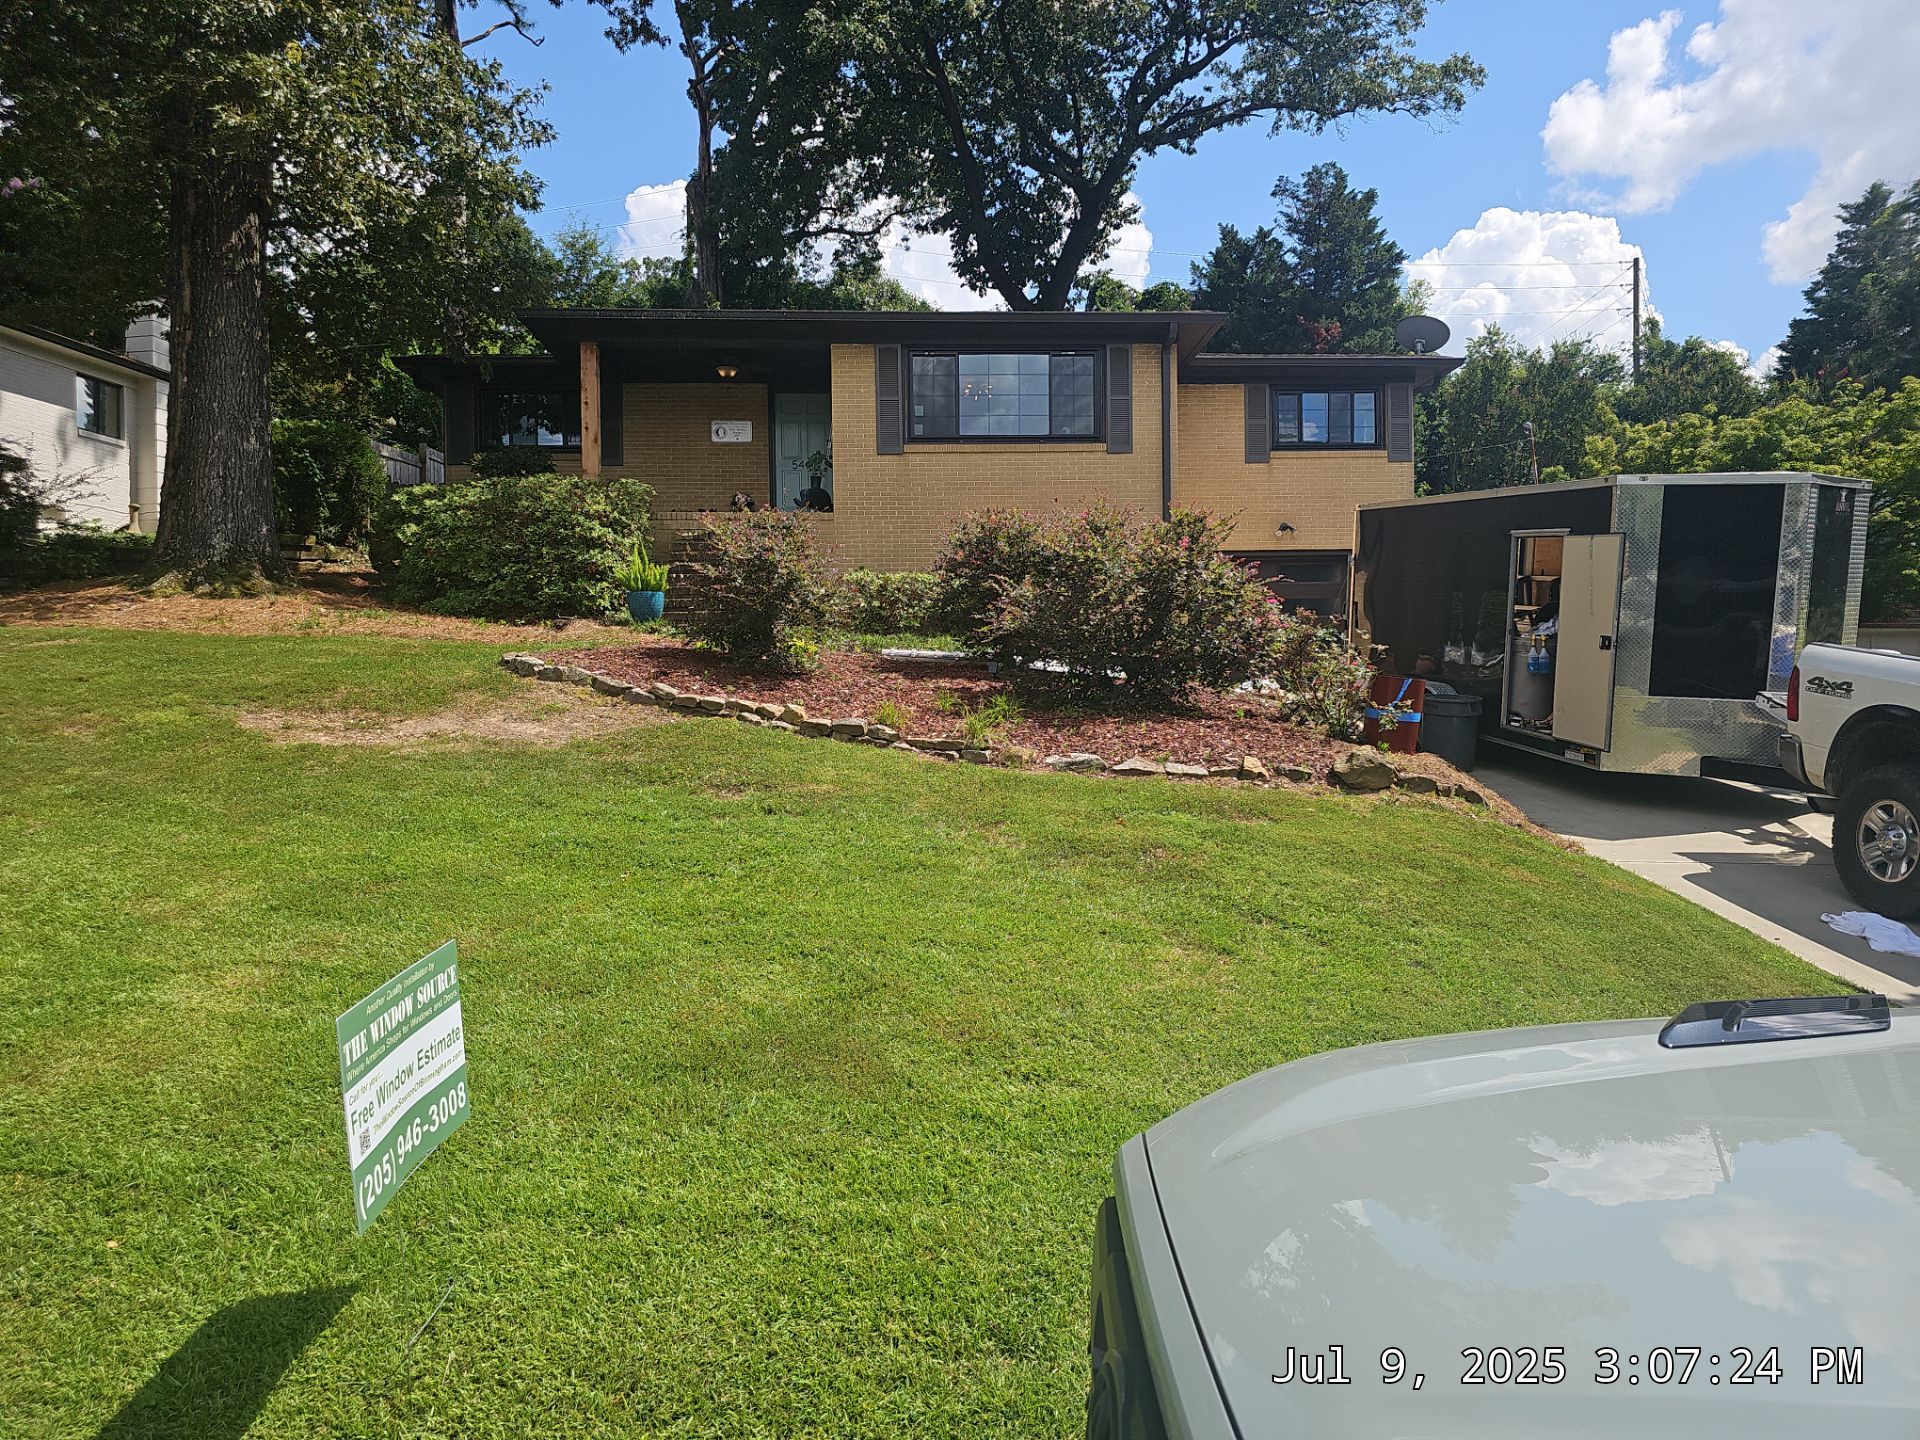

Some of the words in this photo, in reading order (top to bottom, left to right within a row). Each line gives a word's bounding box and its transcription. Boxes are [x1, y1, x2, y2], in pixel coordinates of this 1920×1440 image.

[342, 1028, 368, 1067] THE
[370, 993, 414, 1045] WINDOW
[416, 964, 457, 1009] SOURCE
[365, 1045, 386, 1067] America
[402, 1023, 410, 1035] for
[410, 1007, 433, 1027] Windows
[433, 997, 443, 1012] and
[443, 989, 458, 1005] Doors
[386, 983, 403, 1001] Quality
[428, 962, 435, 972] by
[350, 1100, 375, 1136] Free
[376, 1061, 414, 1109] Window
[416, 1026, 461, 1071] Estimate
[359, 1148, 396, 1221] (205)
[397, 1081, 467, 1165] 946-3008
